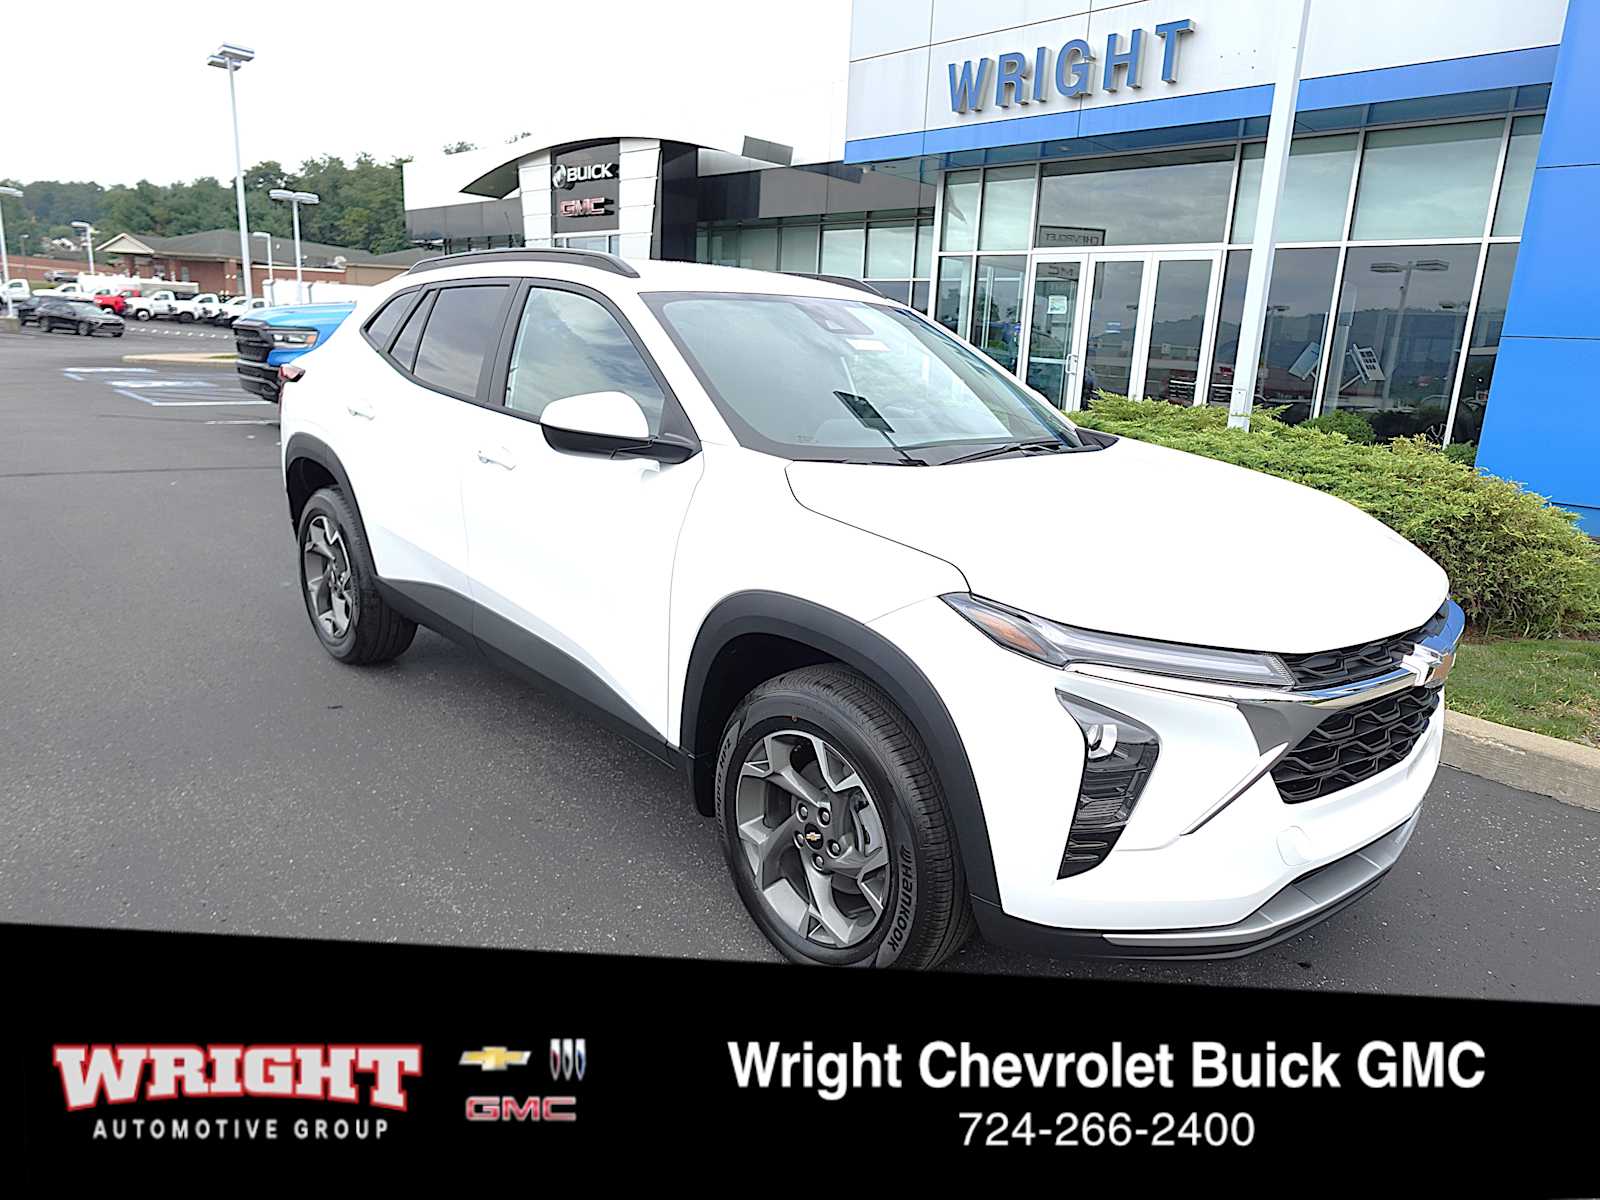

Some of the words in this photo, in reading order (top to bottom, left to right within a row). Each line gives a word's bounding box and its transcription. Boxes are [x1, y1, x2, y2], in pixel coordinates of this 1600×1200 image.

[948, 18, 1196, 114] WRIGHT
[566, 163, 613, 182] BUICK
[560, 197, 605, 217] GMC
